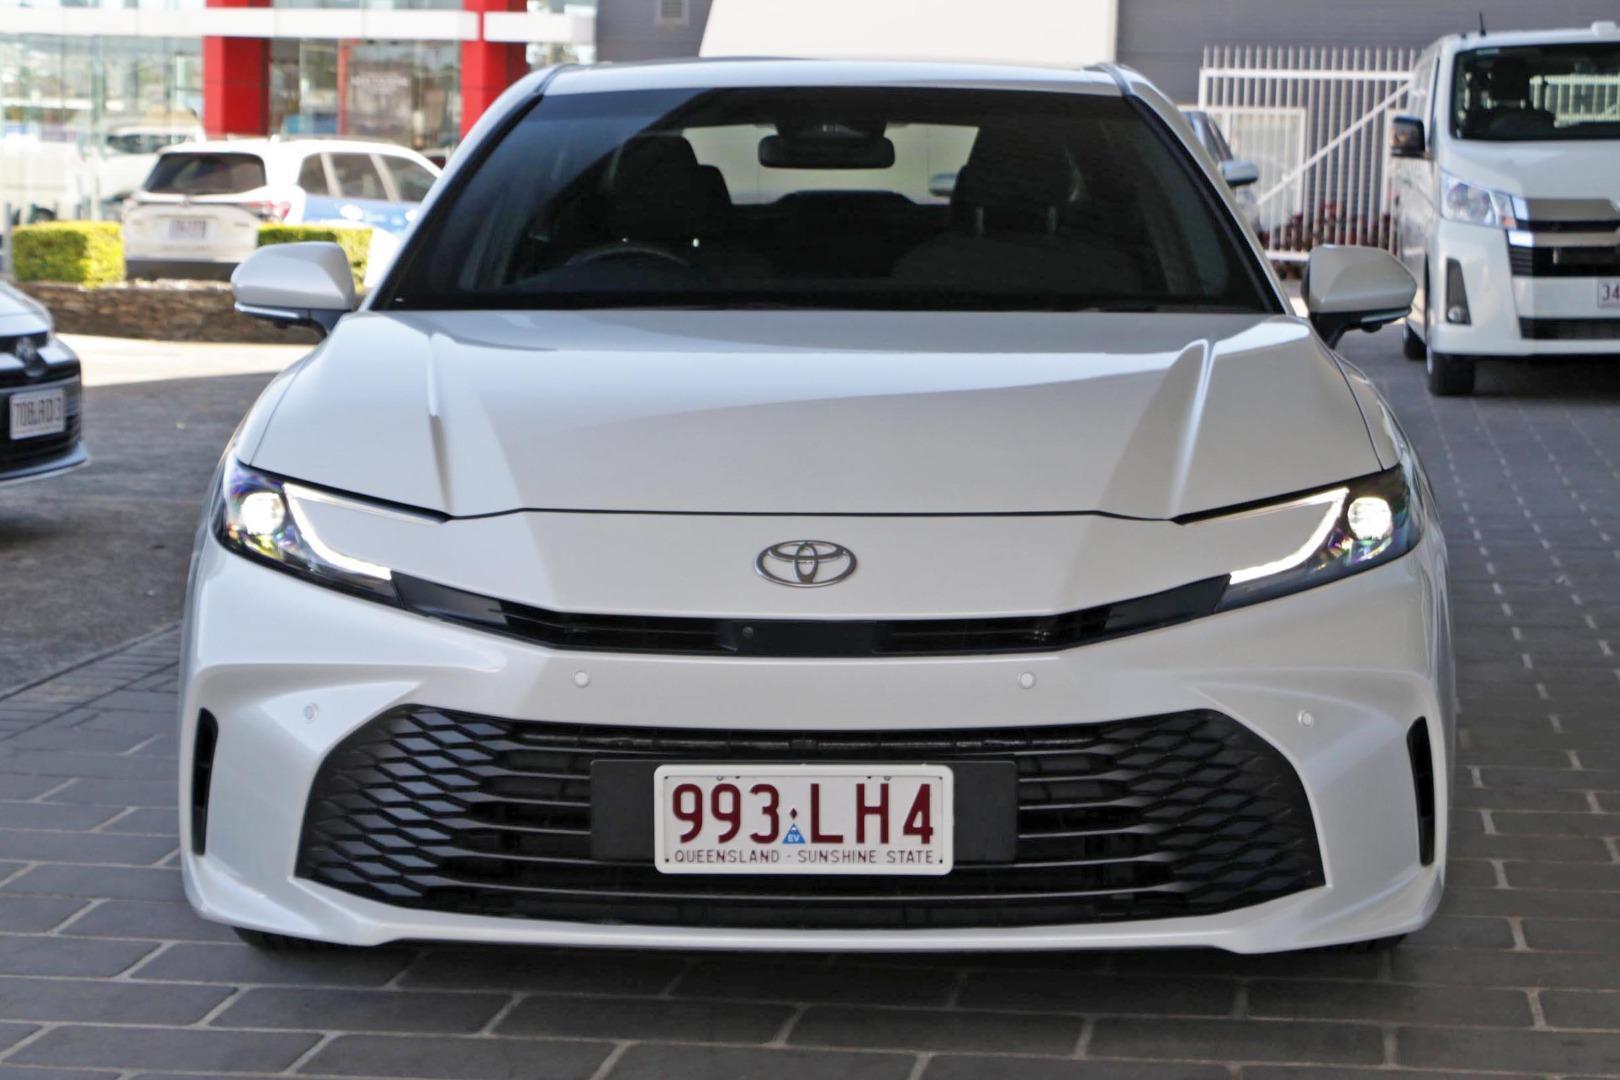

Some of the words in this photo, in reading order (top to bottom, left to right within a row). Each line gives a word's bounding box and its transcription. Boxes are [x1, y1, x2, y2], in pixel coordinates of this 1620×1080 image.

[672, 783, 780, 845] 993
[810, 783, 934, 845] LH4
[787, 834, 800, 842] EV
[674, 849, 780, 864] QUEENSLAND
[797, 849, 877, 864] SUNSHINE
[886, 849, 934, 864] STATE
